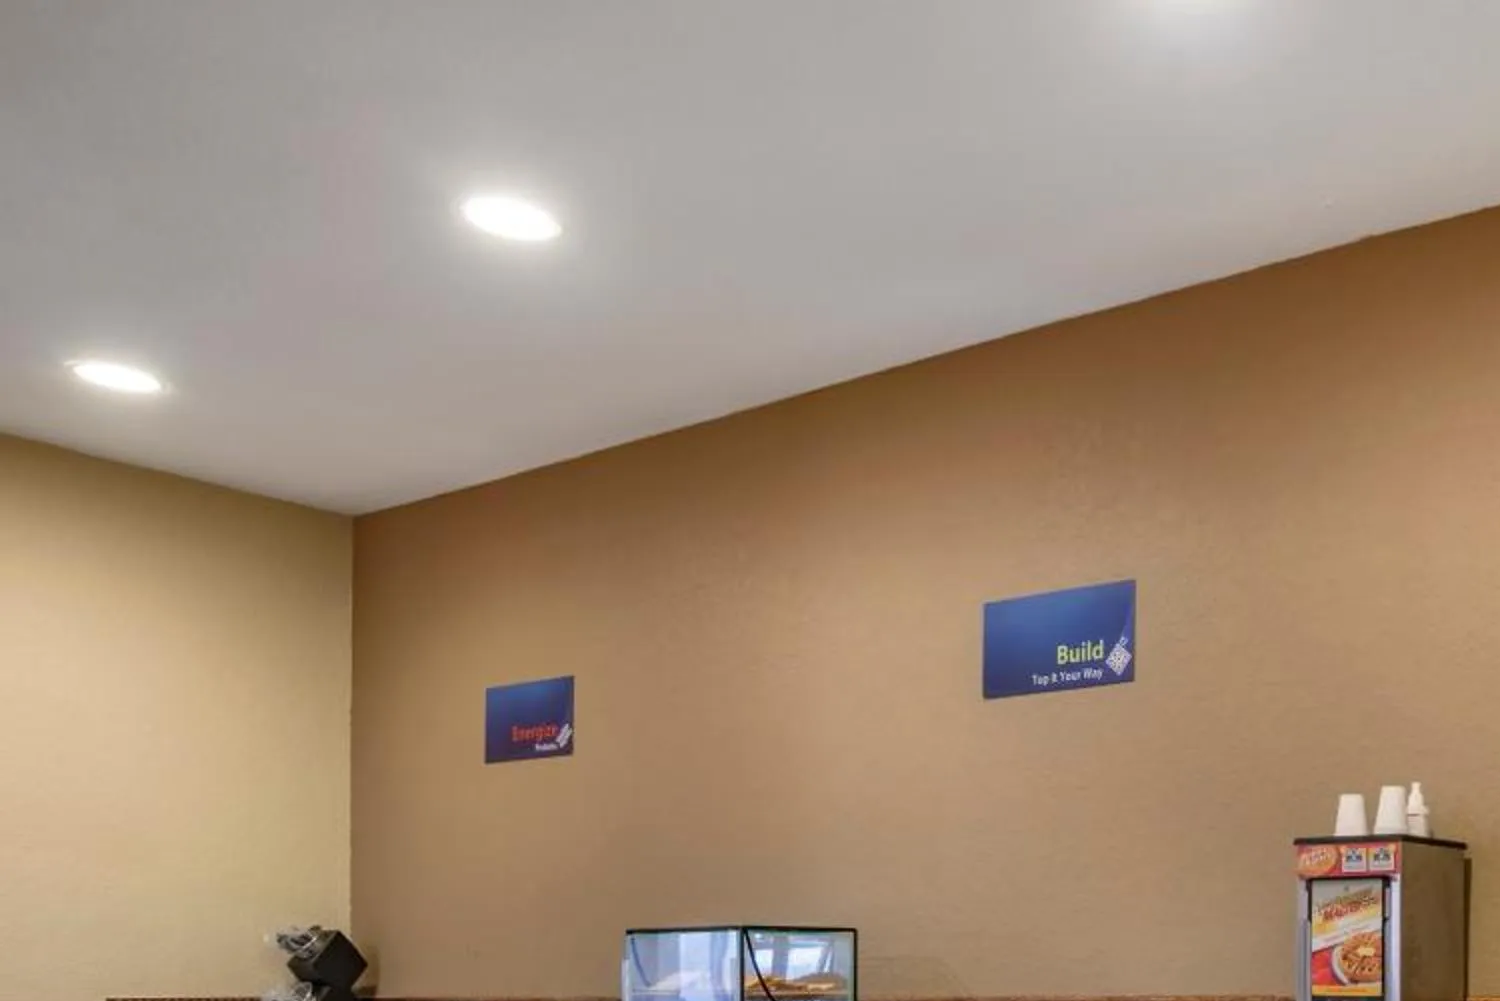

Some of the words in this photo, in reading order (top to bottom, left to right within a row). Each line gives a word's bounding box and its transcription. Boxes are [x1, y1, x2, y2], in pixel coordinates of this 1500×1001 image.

[1057, 639, 1104, 665] Build
[1033, 674, 1049, 686] Top
[1060, 671, 1081, 682] Your
[1083, 667, 1103, 681] Way
